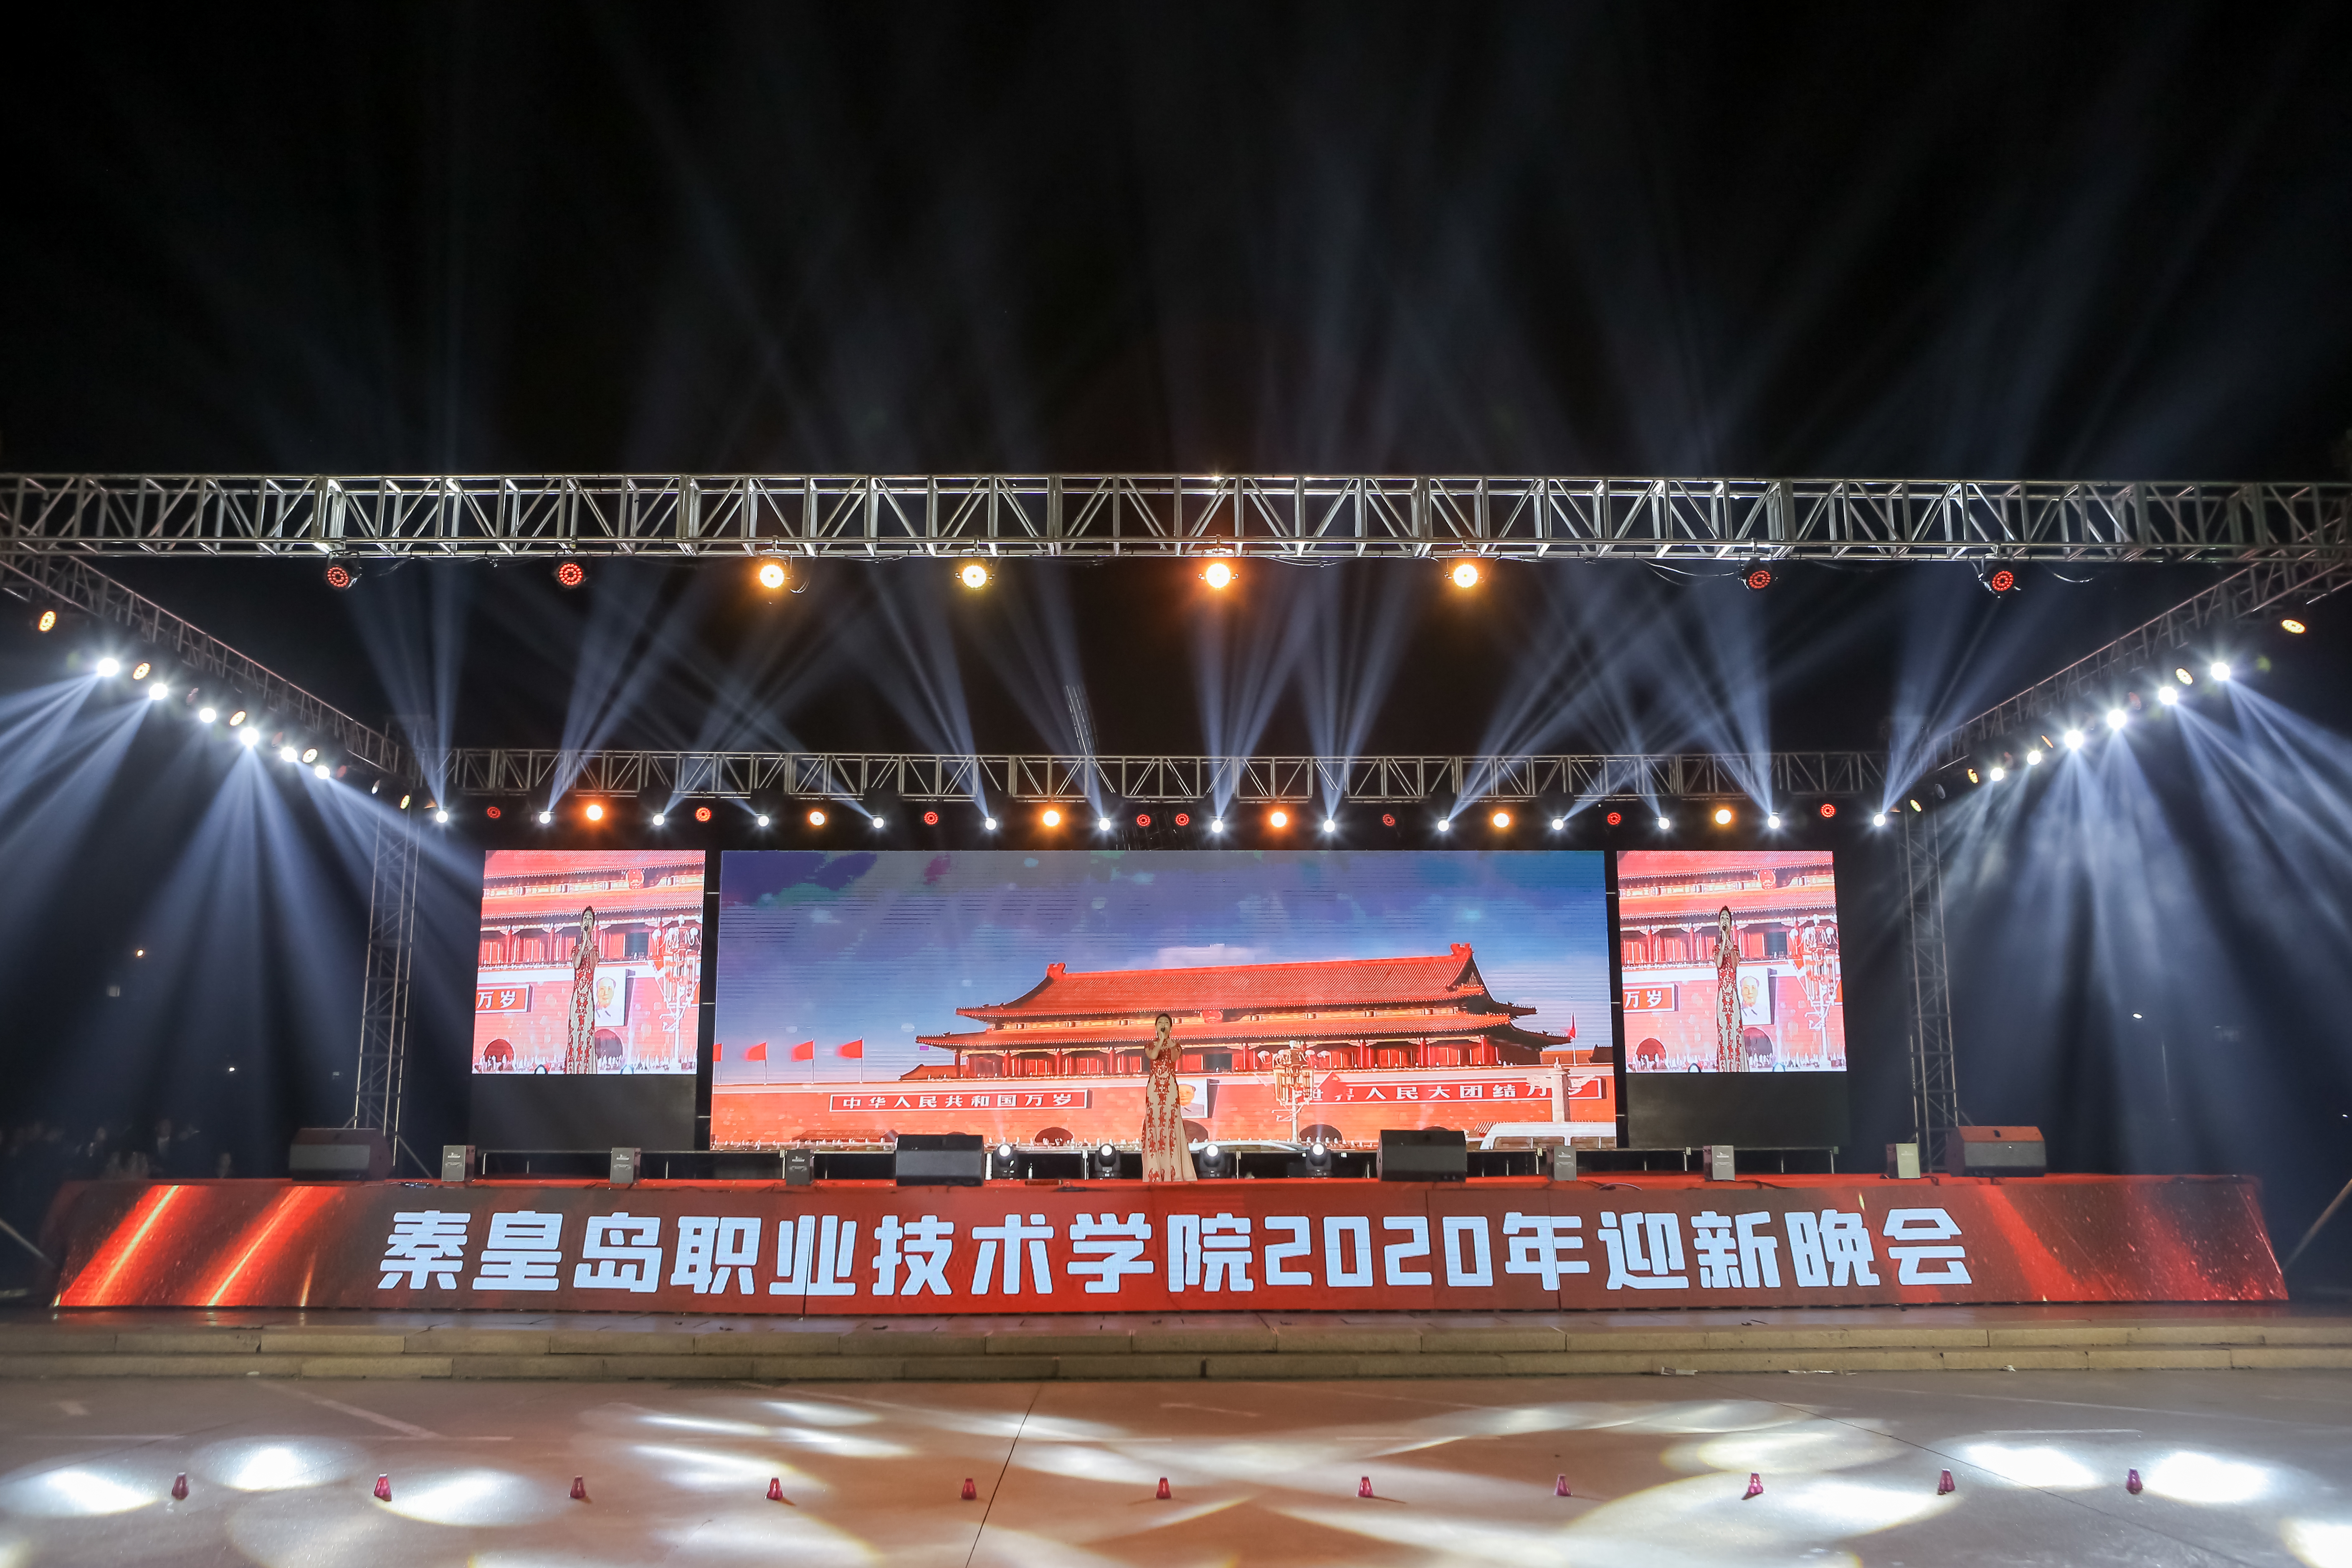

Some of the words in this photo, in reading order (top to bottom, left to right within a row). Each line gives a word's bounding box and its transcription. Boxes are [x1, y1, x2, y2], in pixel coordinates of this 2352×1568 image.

[476, 990, 516, 1009] 万岁
[1624, 990, 1663, 1008] 万岁
[843, 1093, 1072, 1109] 中华人民共和国万岁
[377, 1208, 1972, 1296] 秦皇岛职业技术学院2020年迎新晚会
